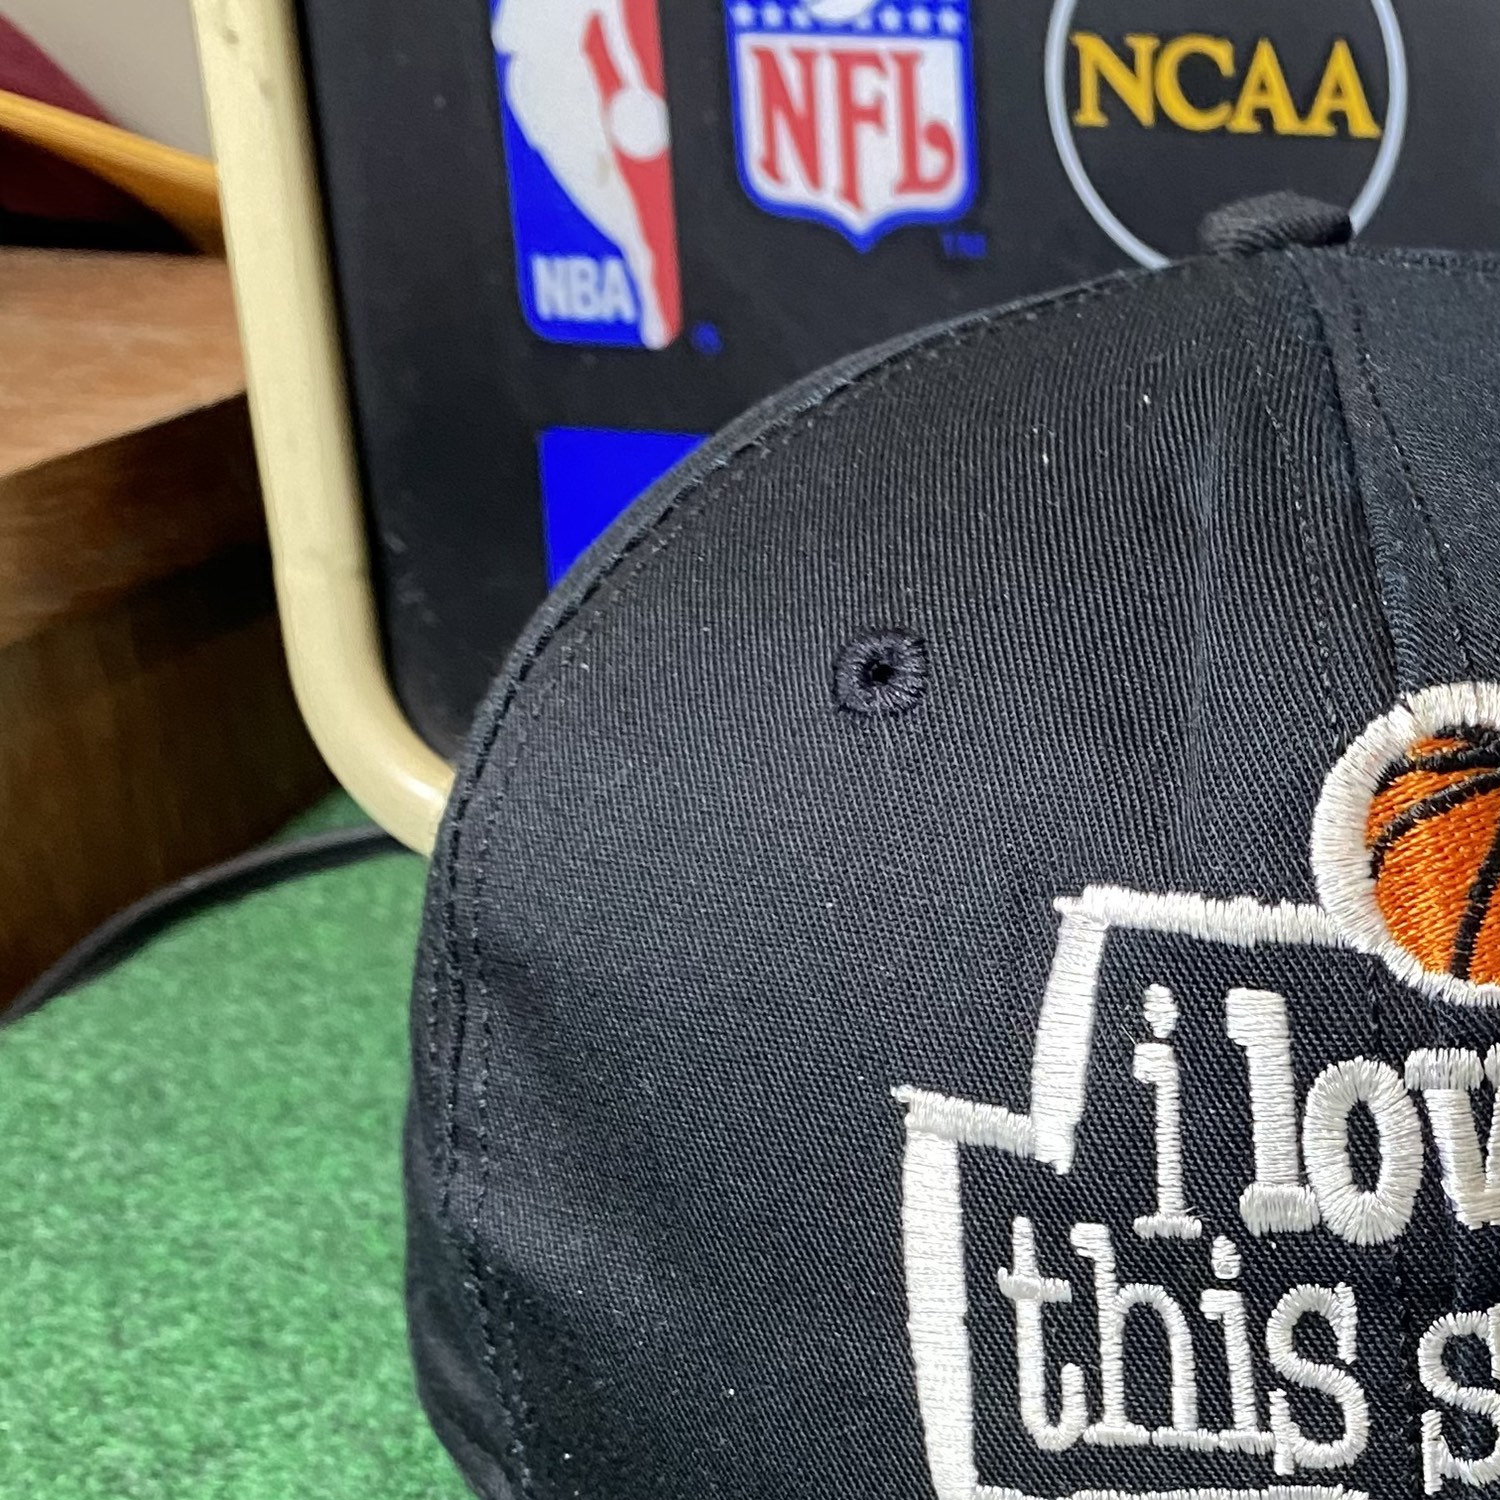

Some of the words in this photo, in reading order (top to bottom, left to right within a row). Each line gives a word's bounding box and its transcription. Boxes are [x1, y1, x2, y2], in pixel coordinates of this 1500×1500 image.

[751, 46, 957, 213] NFL
[1072, 33, 1382, 139] NCAA
[531, 254, 638, 323] NBA
[1133, 985, 1203, 1237] i
[998, 1216, 1372, 1476] this
